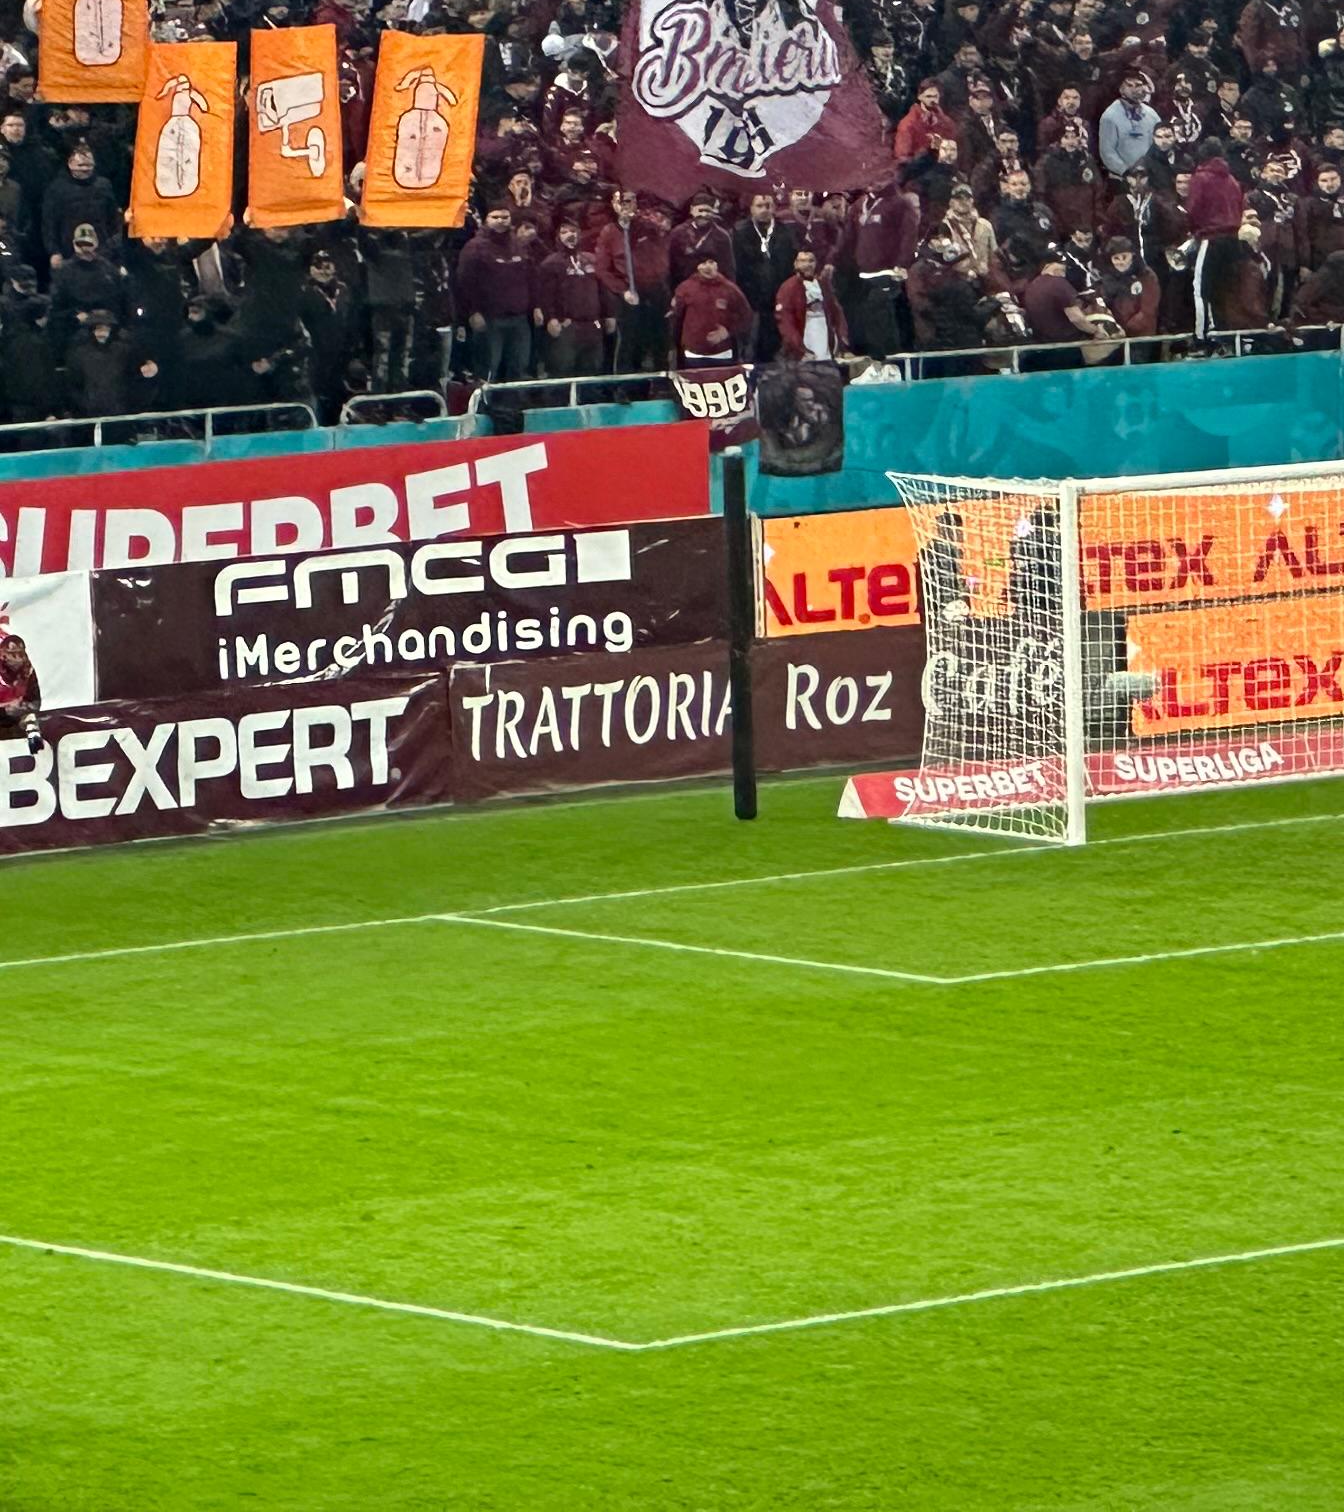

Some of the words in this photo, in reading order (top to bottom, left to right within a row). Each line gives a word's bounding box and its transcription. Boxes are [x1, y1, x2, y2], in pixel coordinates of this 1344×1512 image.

[0, 443, 548, 578] UPERBET
[218, 611, 634, 681] iMerchandising
[786, 663, 894, 731] Roz
[893, 762, 1047, 804] SUPERBET
[1115, 741, 1285, 784] SUPERLIGA
